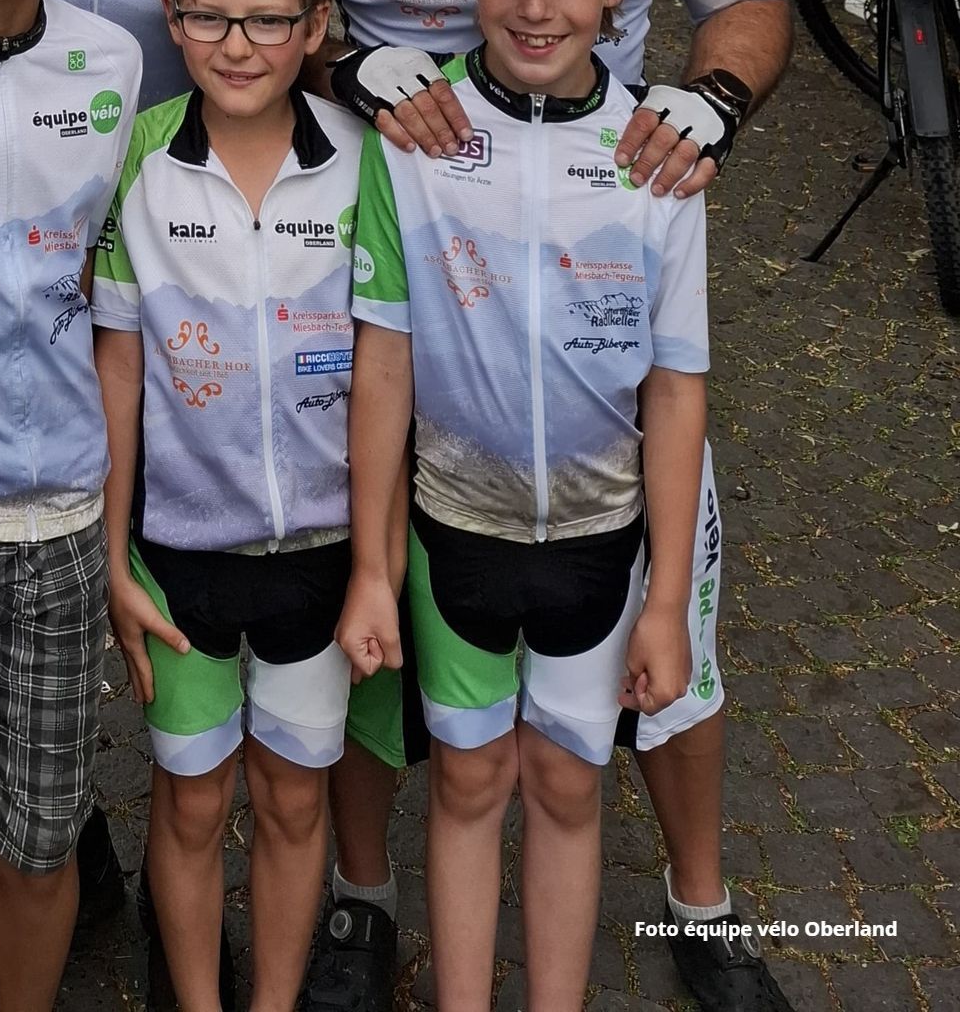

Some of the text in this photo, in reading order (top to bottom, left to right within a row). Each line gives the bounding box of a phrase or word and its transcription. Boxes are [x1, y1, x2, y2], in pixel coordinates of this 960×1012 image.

[32, 103, 121, 129] équipe vélo
[60, 128, 87, 137] OBERLAND
[567, 165, 615, 179] équipe
[169, 221, 216, 238] kalas
[274, 219, 335, 237] équipe
[354, 256, 372, 272] élo
[575, 261, 633, 271] Kreissparkasse
[575, 271, 645, 283] Miesbach-Tegerns
[292, 311, 346, 321] Kreissparkas
[590, 315, 640, 328] Radlkeller
[563, 336, 640, 354] Auto-Biberger
[225, 362, 252, 371] HOF
[297, 365, 312, 373] BIKE
[704, 488, 719, 574] vélo
